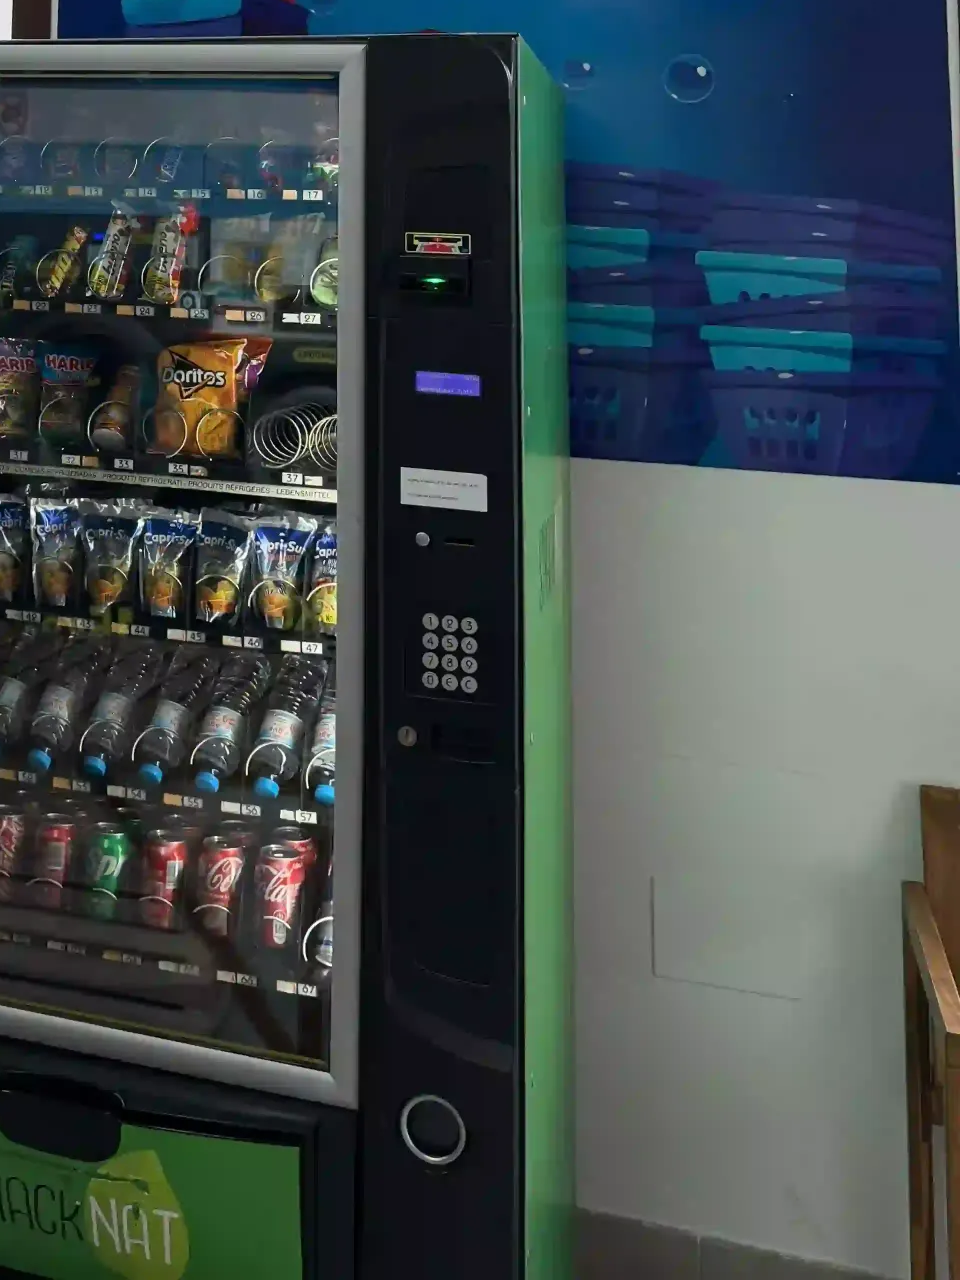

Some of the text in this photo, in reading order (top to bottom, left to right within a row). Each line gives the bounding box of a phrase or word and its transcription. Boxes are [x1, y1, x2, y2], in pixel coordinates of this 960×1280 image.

[304, 314, 317, 323] 27
[162, 366, 226, 386] Doritos
[118, 460, 129, 468] 33
[173, 464, 184, 473] 35
[286, 474, 299, 483] 37
[143, 532, 194, 545] Capri-Su
[247, 638, 261, 647] 46
[305, 643, 318, 652] 47
[245, 805, 259, 816] 56
[299, 812, 312, 822] 57
